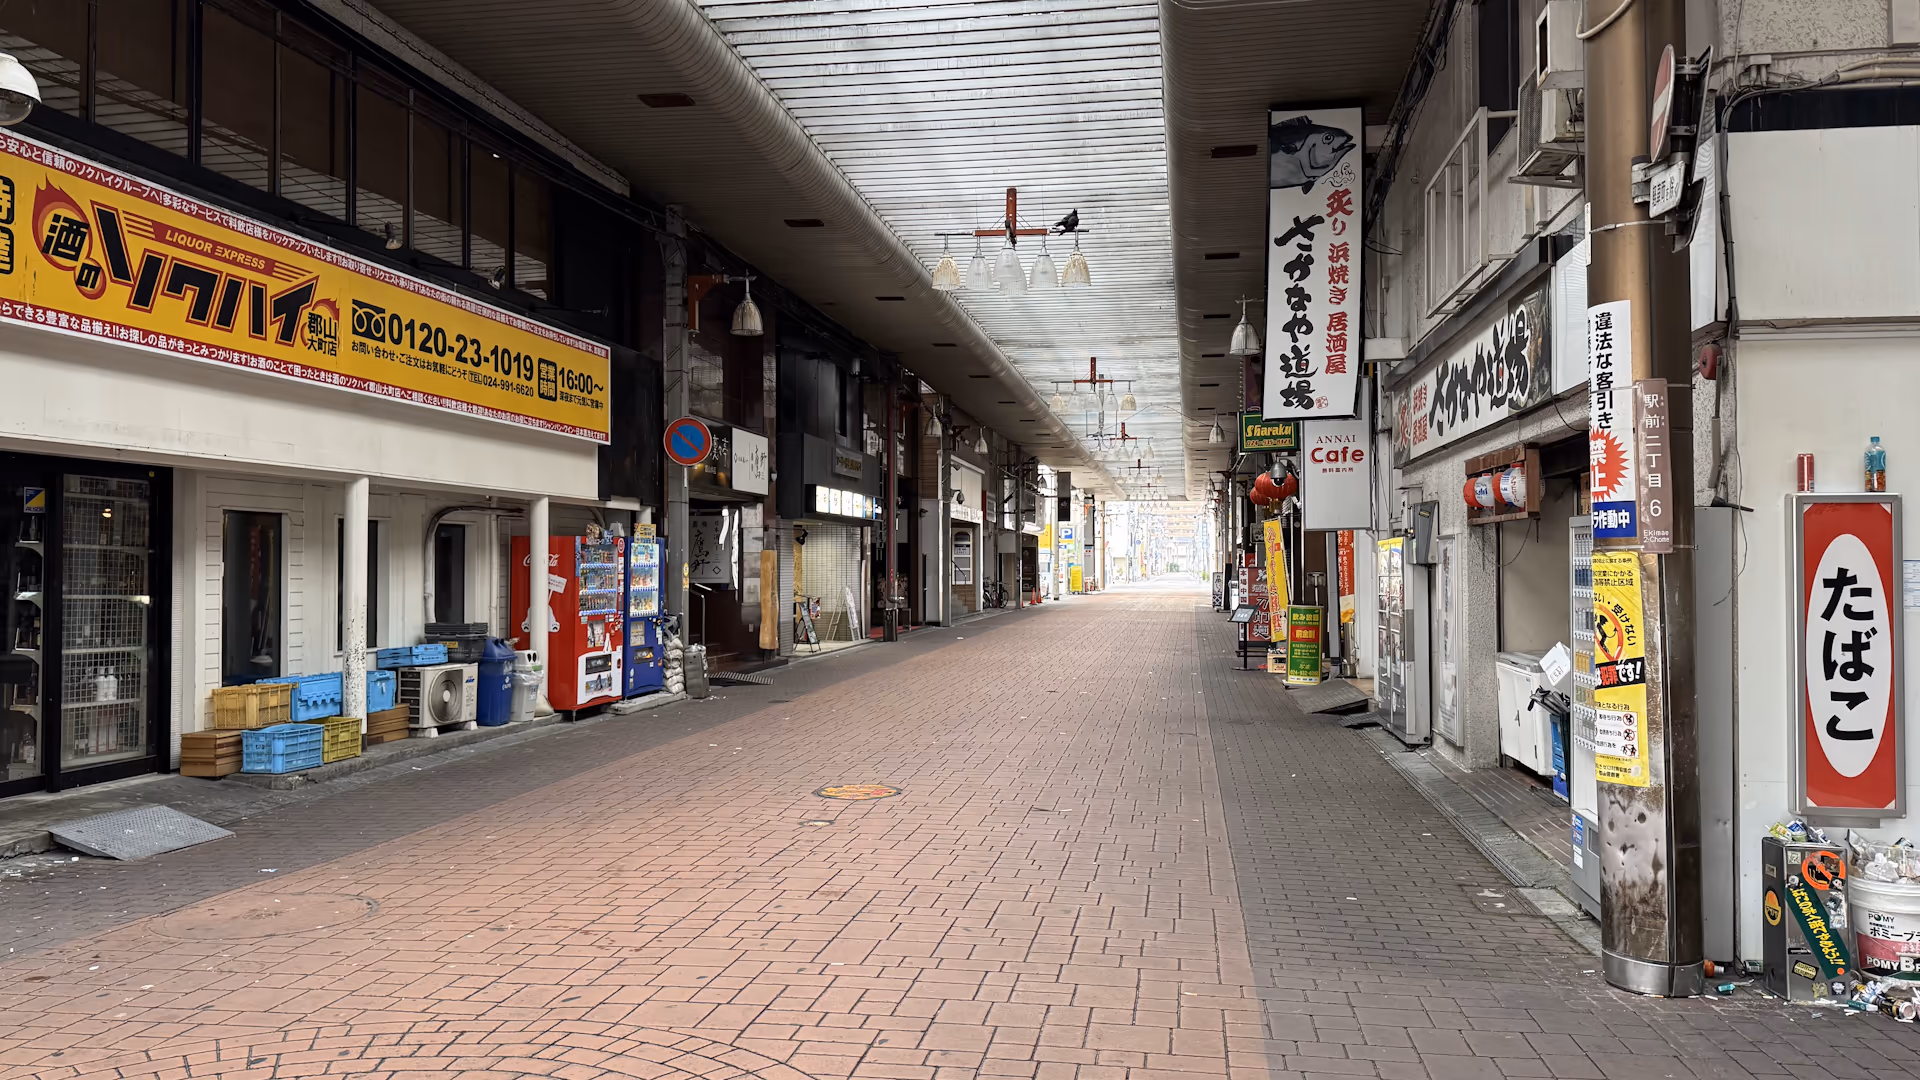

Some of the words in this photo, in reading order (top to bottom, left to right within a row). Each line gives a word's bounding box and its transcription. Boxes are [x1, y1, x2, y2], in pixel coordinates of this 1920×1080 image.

[1325, 188, 1354, 236] 炙り
[165, 229, 213, 254] LIQUOR
[215, 246, 266, 270] EXPRESS
[91, 202, 317, 345] ソクハイ
[1327, 241, 1350, 305] 浜焼き
[307, 311, 338, 342] 郡山
[1274, 214, 1325, 411] さかなや道場
[307, 335, 337, 358] 大町店
[352, 340, 467, 380] お問い合わせ・ご注文はお気軽にどうぞ
[387, 312, 534, 382] 0120-23-1019
[1325, 311, 1348, 375] 居酒屋
[470, 372, 482, 384] TEL
[483, 375, 534, 398] 024-991-6620
[539, 361, 556, 381] 営業
[539, 379, 556, 398] 時間
[1428, 307, 1529, 437] さかなや道場
[1595, 311, 1613, 428] 違法な客引き
[1246, 423, 1292, 437] Sharaku
[1316, 434, 1356, 444] ANNAI
[1643, 393, 1662, 488] 駅前二丁目
[1310, 446, 1365, 464] Cafe
[1590, 439, 1607, 492] 禁止
[1592, 509, 1630, 529] ラ作動中
[1649, 499, 1662, 517] 6
[1061, 528, 1072, 539] P
[1820, 566, 1878, 741] たばこ
[1790, 883, 1845, 965] ばこのポイ捨てやめよう!!
[1866, 955, 1899, 971] POMY
